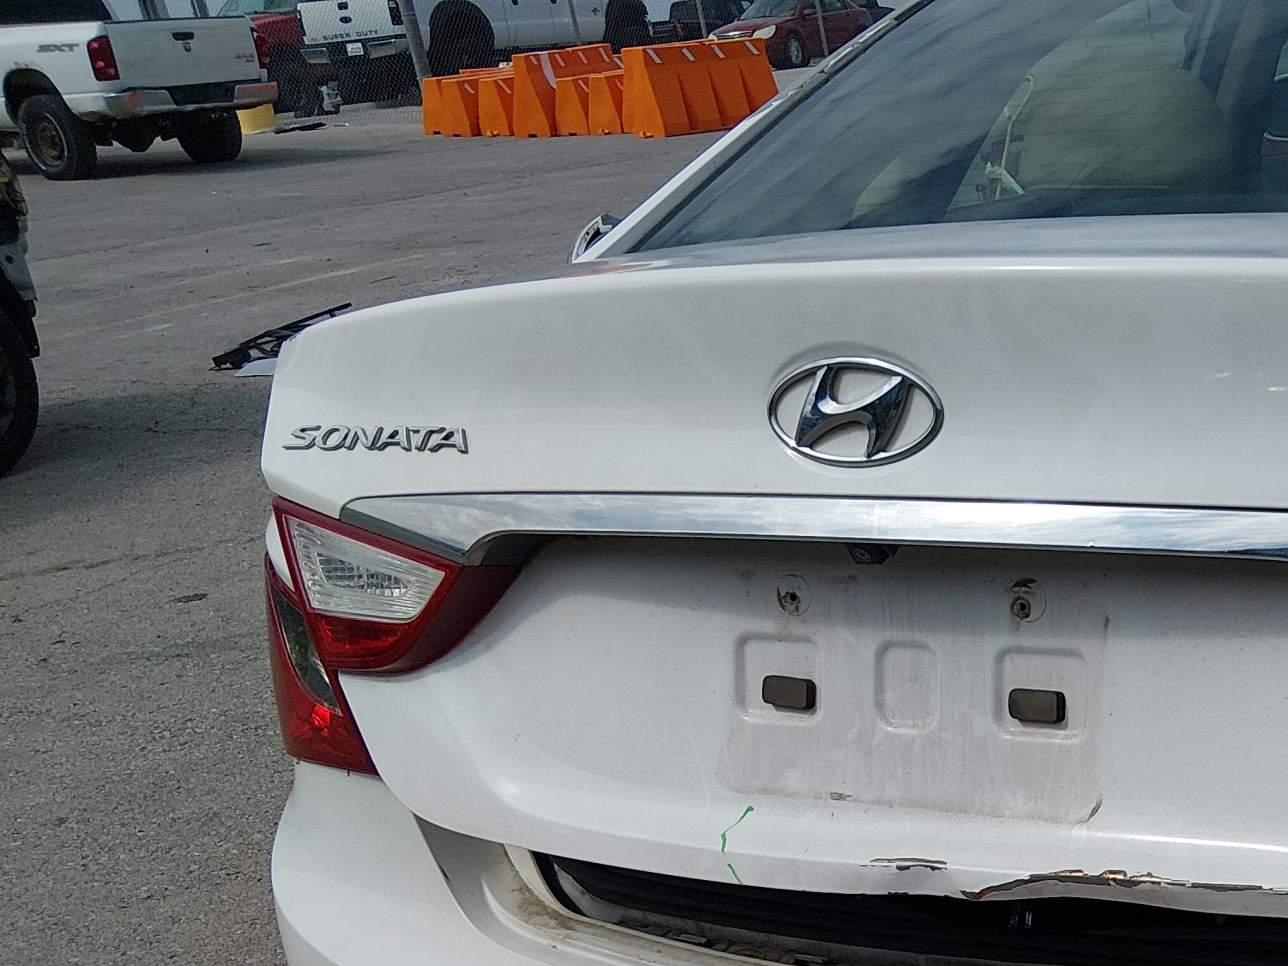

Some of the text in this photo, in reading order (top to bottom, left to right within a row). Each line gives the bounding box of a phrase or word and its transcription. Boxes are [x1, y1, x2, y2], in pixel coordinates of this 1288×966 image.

[322, 32, 351, 41] SUPER
[355, 29, 378, 37] DUTY
[37, 43, 79, 53] SXT
[282, 424, 470, 455] SONATA
